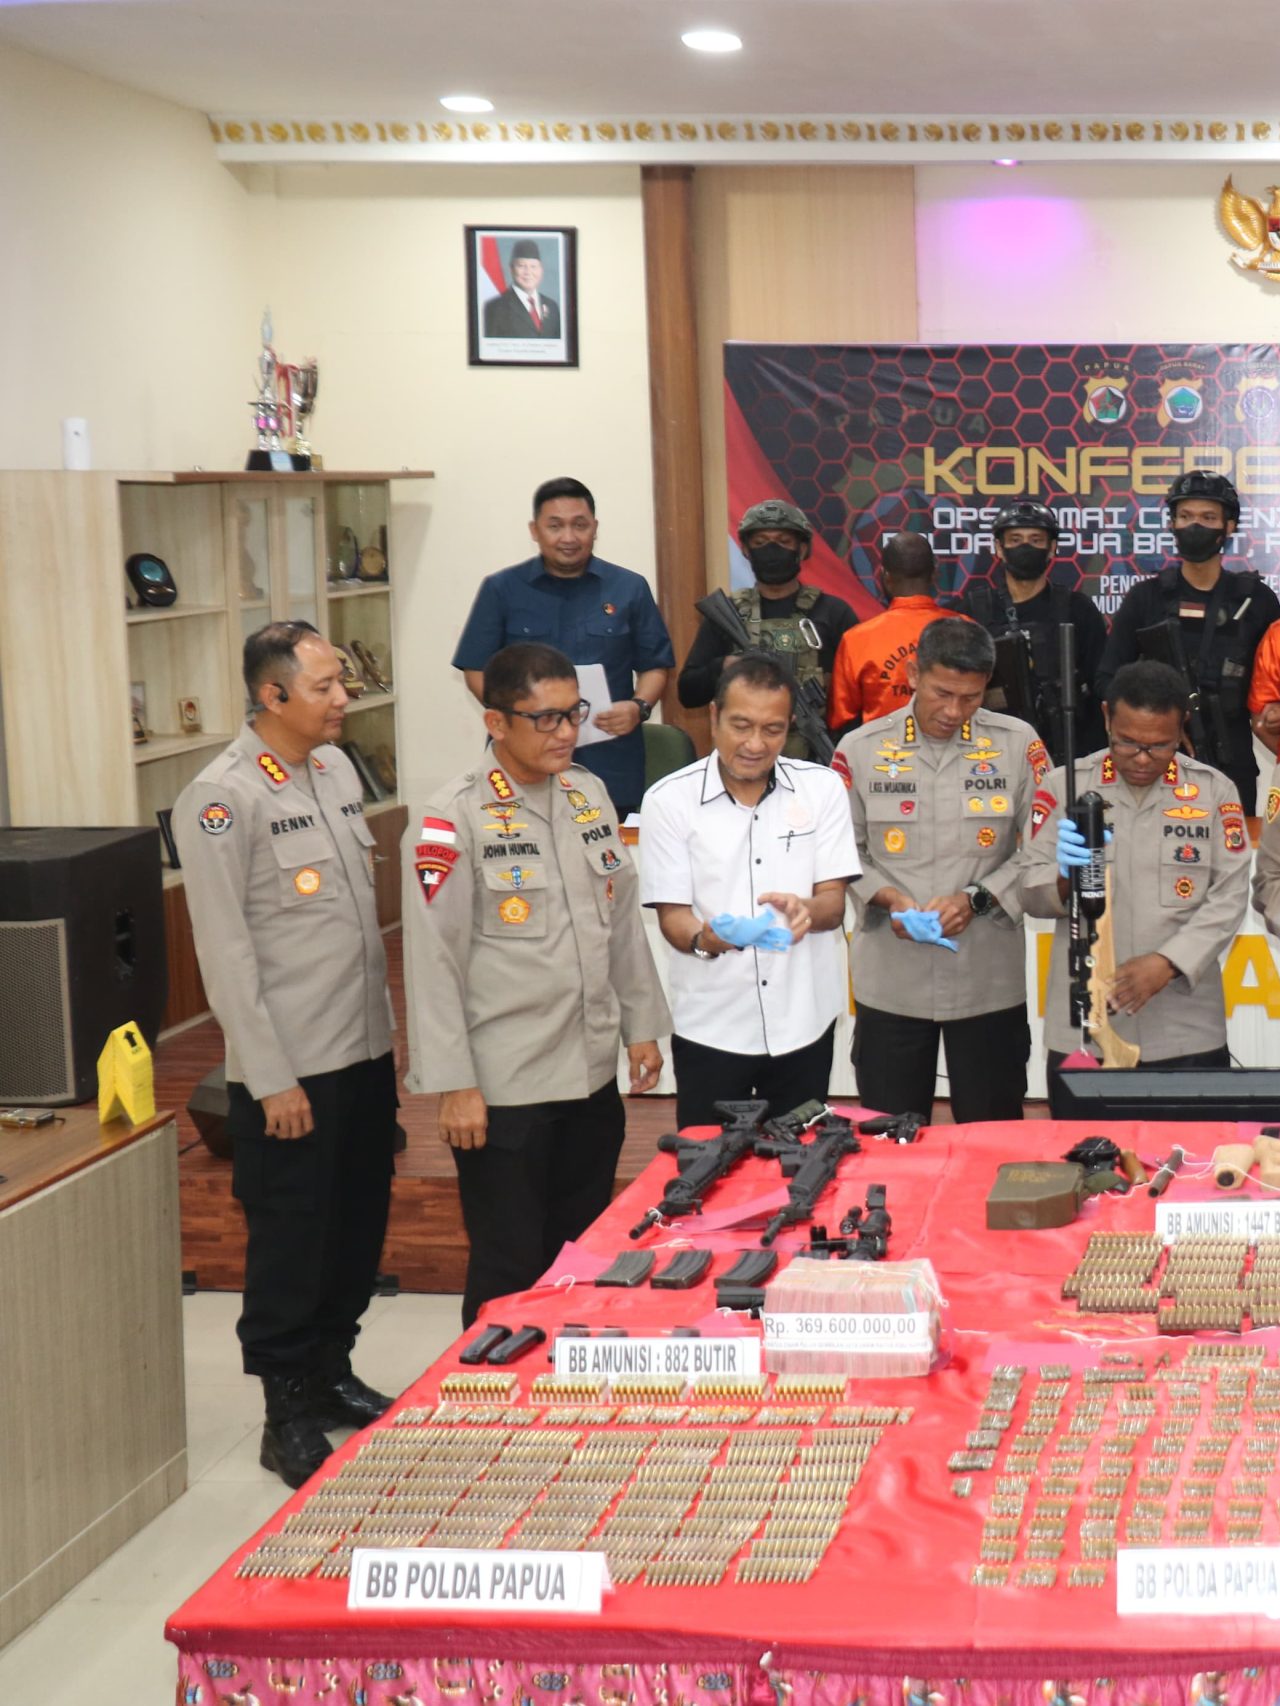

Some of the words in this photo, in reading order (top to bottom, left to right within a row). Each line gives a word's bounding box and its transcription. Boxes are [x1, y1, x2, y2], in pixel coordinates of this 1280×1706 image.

[933, 507, 1001, 529] OPS
[1133, 532, 1254, 558] BAT,
[964, 777, 1007, 791] POLRI
[270, 814, 316, 836] BENNY
[581, 823, 612, 845] POLRI
[1163, 824, 1210, 839] POLRI
[483, 843, 507, 859] JOHN
[1167, 1212, 1182, 1235] BB
[1186, 1212, 1234, 1234] AMUNISI
[1245, 1212, 1270, 1234] 1447
[795, 1317, 916, 1338] 369.600.000,00
[568, 1345, 588, 1372] BB
[592, 1345, 653, 1373] AMUNISI
[665, 1345, 690, 1373] 882
[694, 1344, 737, 1373] BUTIR
[366, 1560, 398, 1599] BB
[405, 1560, 481, 1599] POLDA
[489, 1562, 566, 1601] PAPUA
[1135, 1563, 1157, 1599] BB
[1163, 1562, 1217, 1598] POLDA
[1224, 1560, 1278, 1597] PAPUA
